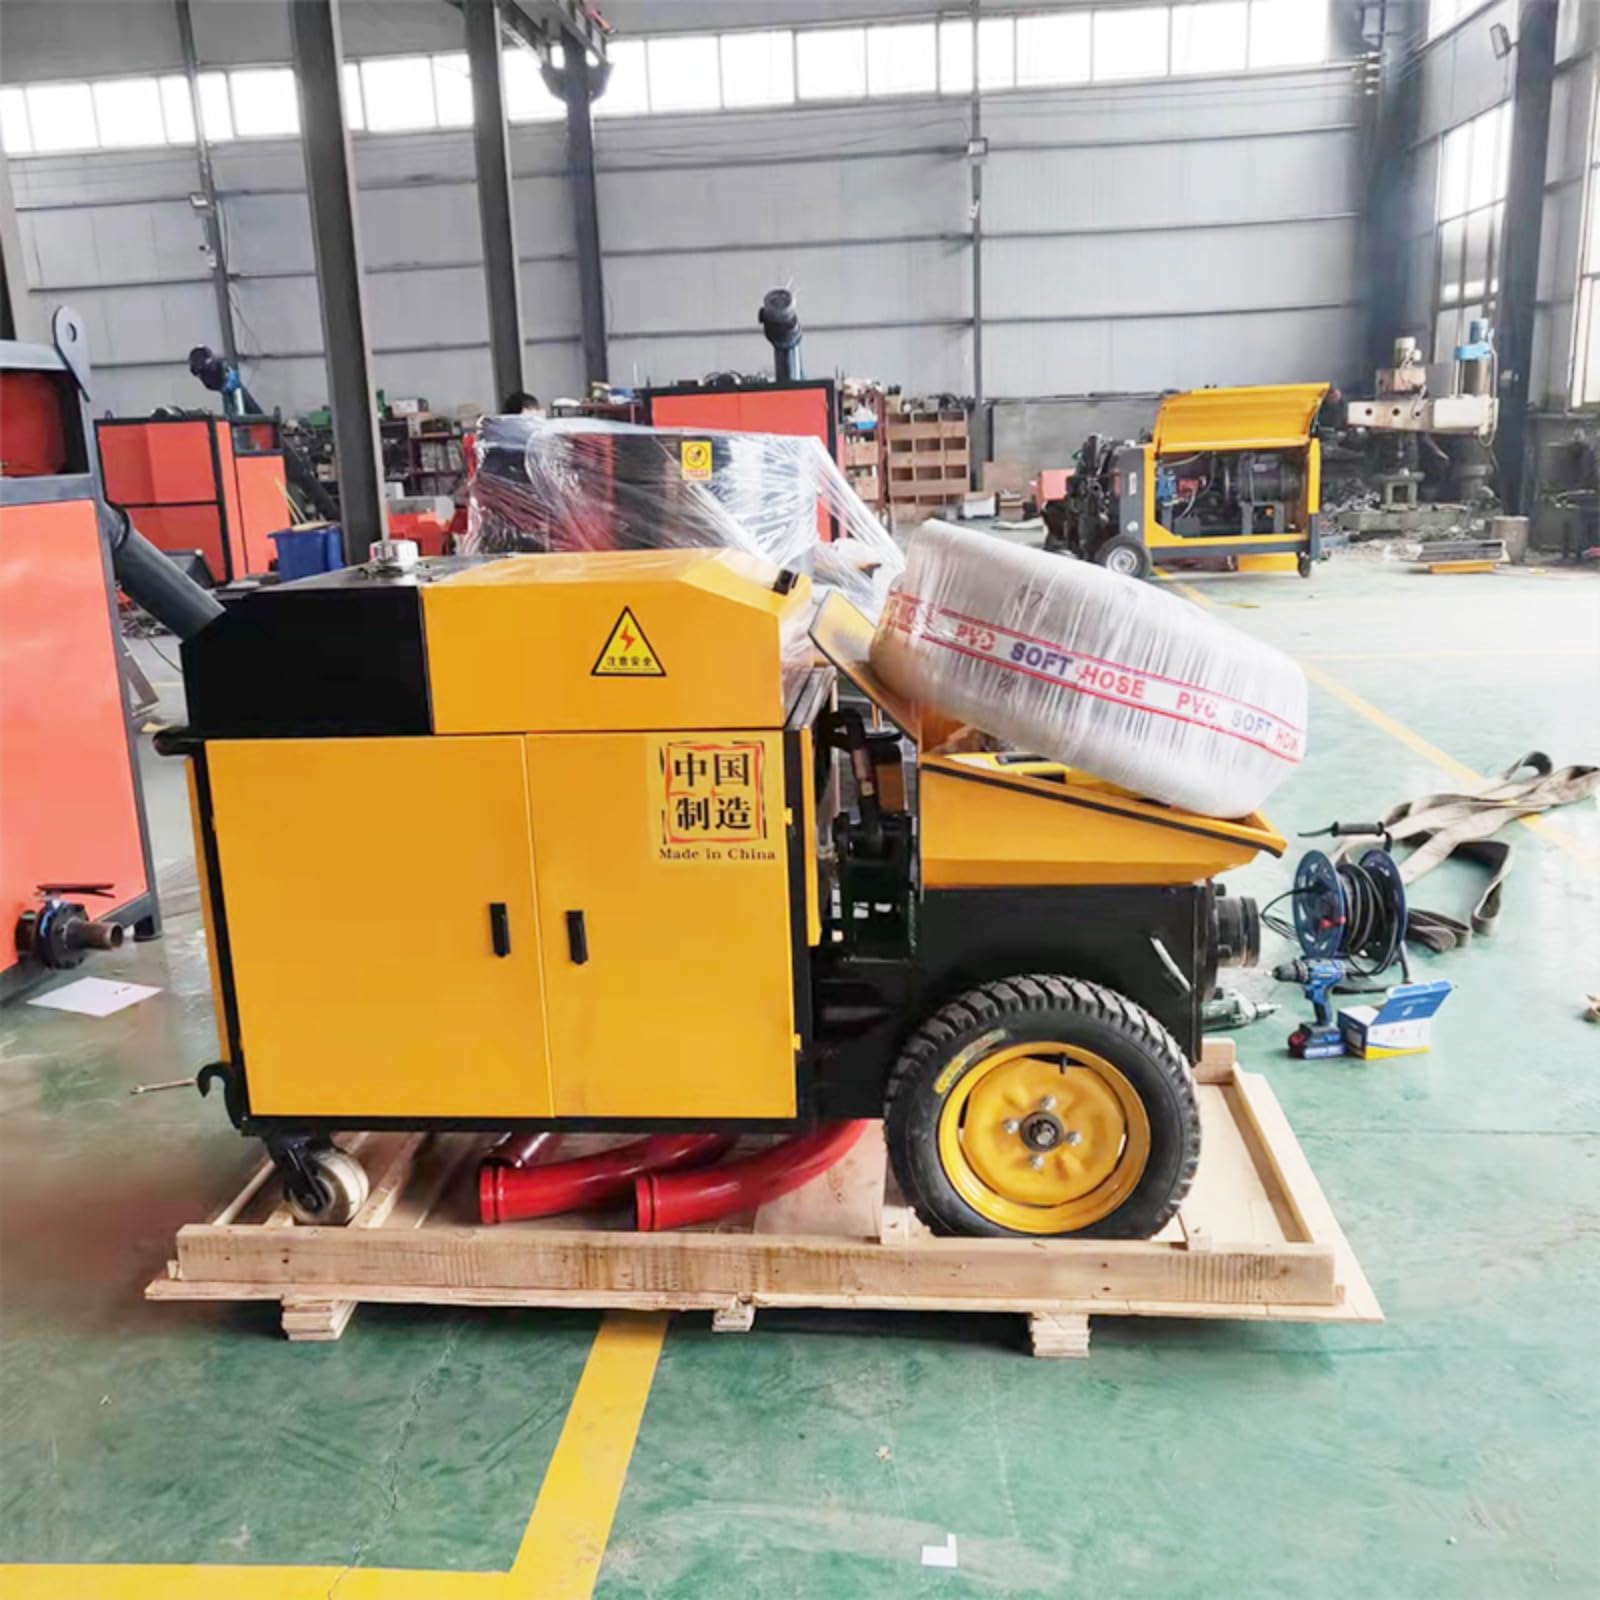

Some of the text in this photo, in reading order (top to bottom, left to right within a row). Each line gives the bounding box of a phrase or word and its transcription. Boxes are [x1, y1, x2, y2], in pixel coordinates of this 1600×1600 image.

[1010, 641, 1074, 676] SOFT
[1079, 664, 1146, 699] HOSE
[1175, 692, 1217, 719] PVC
[1231, 709, 1273, 736] SOFT
[674, 753, 749, 787] 中国
[676, 797, 751, 830] 制造
[659, 848, 776, 860] Made in China
